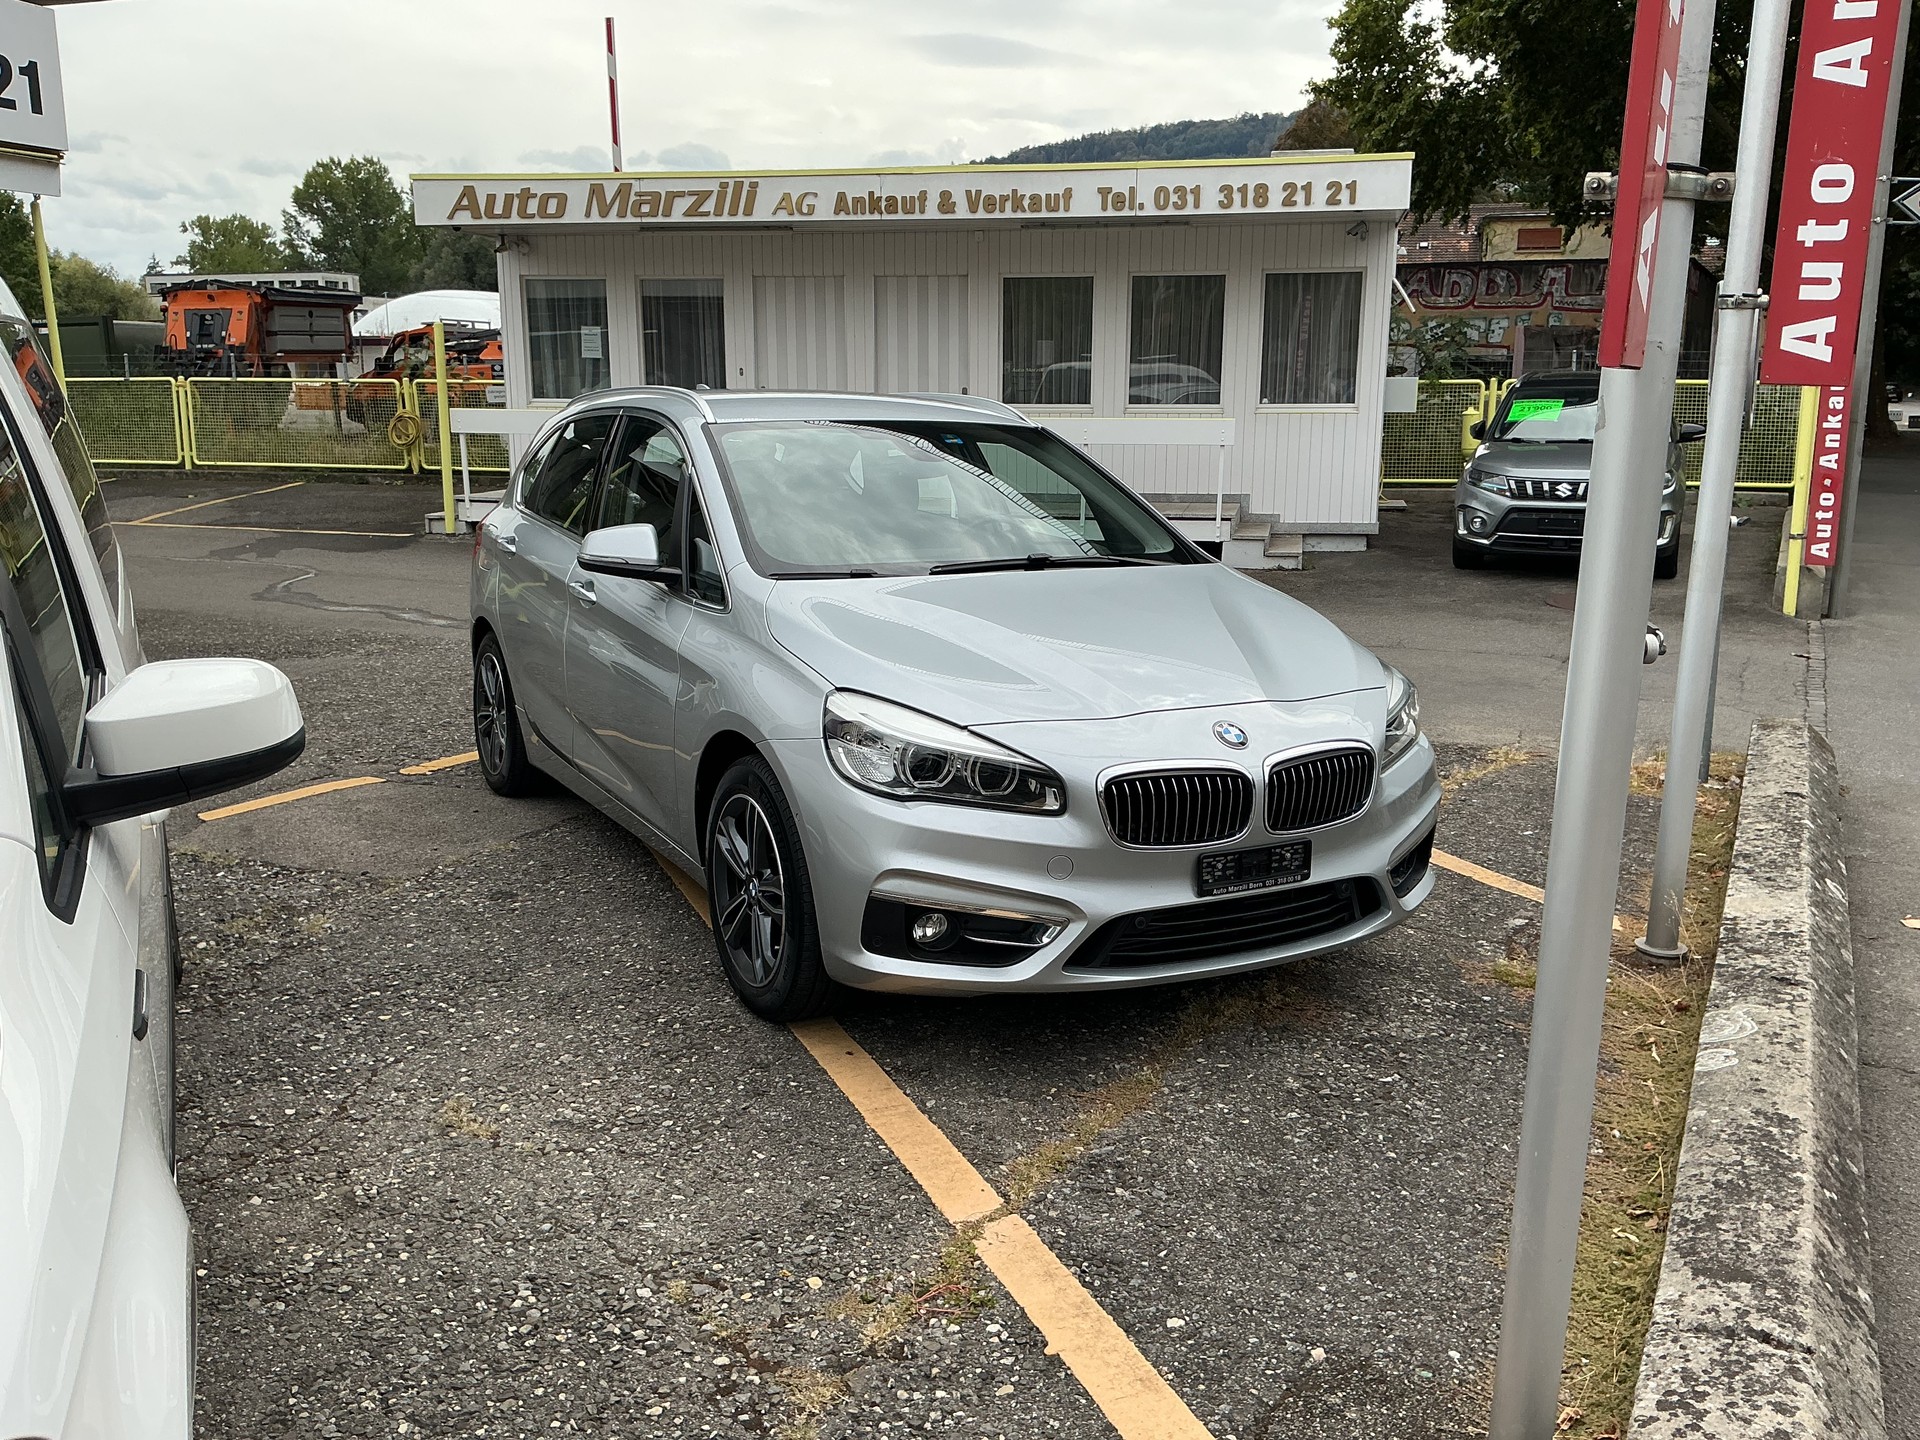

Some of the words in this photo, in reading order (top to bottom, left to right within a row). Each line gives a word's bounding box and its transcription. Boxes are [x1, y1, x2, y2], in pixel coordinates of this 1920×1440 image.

[447, 185, 568, 219] Auto
[585, 180, 759, 218] Marzili
[771, 191, 818, 216] AG
[833, 189, 928, 215] Ankauf
[937, 190, 957, 214] &
[965, 187, 1073, 214] Verkauf
[1153, 184, 1201, 211] 031
[1217, 182, 1269, 209] 318
[1281, 181, 1313, 206] 21
[1325, 179, 1358, 205] 21
[1780, 163, 1855, 363] Auto
[1810, 491, 1835, 559] Auto
